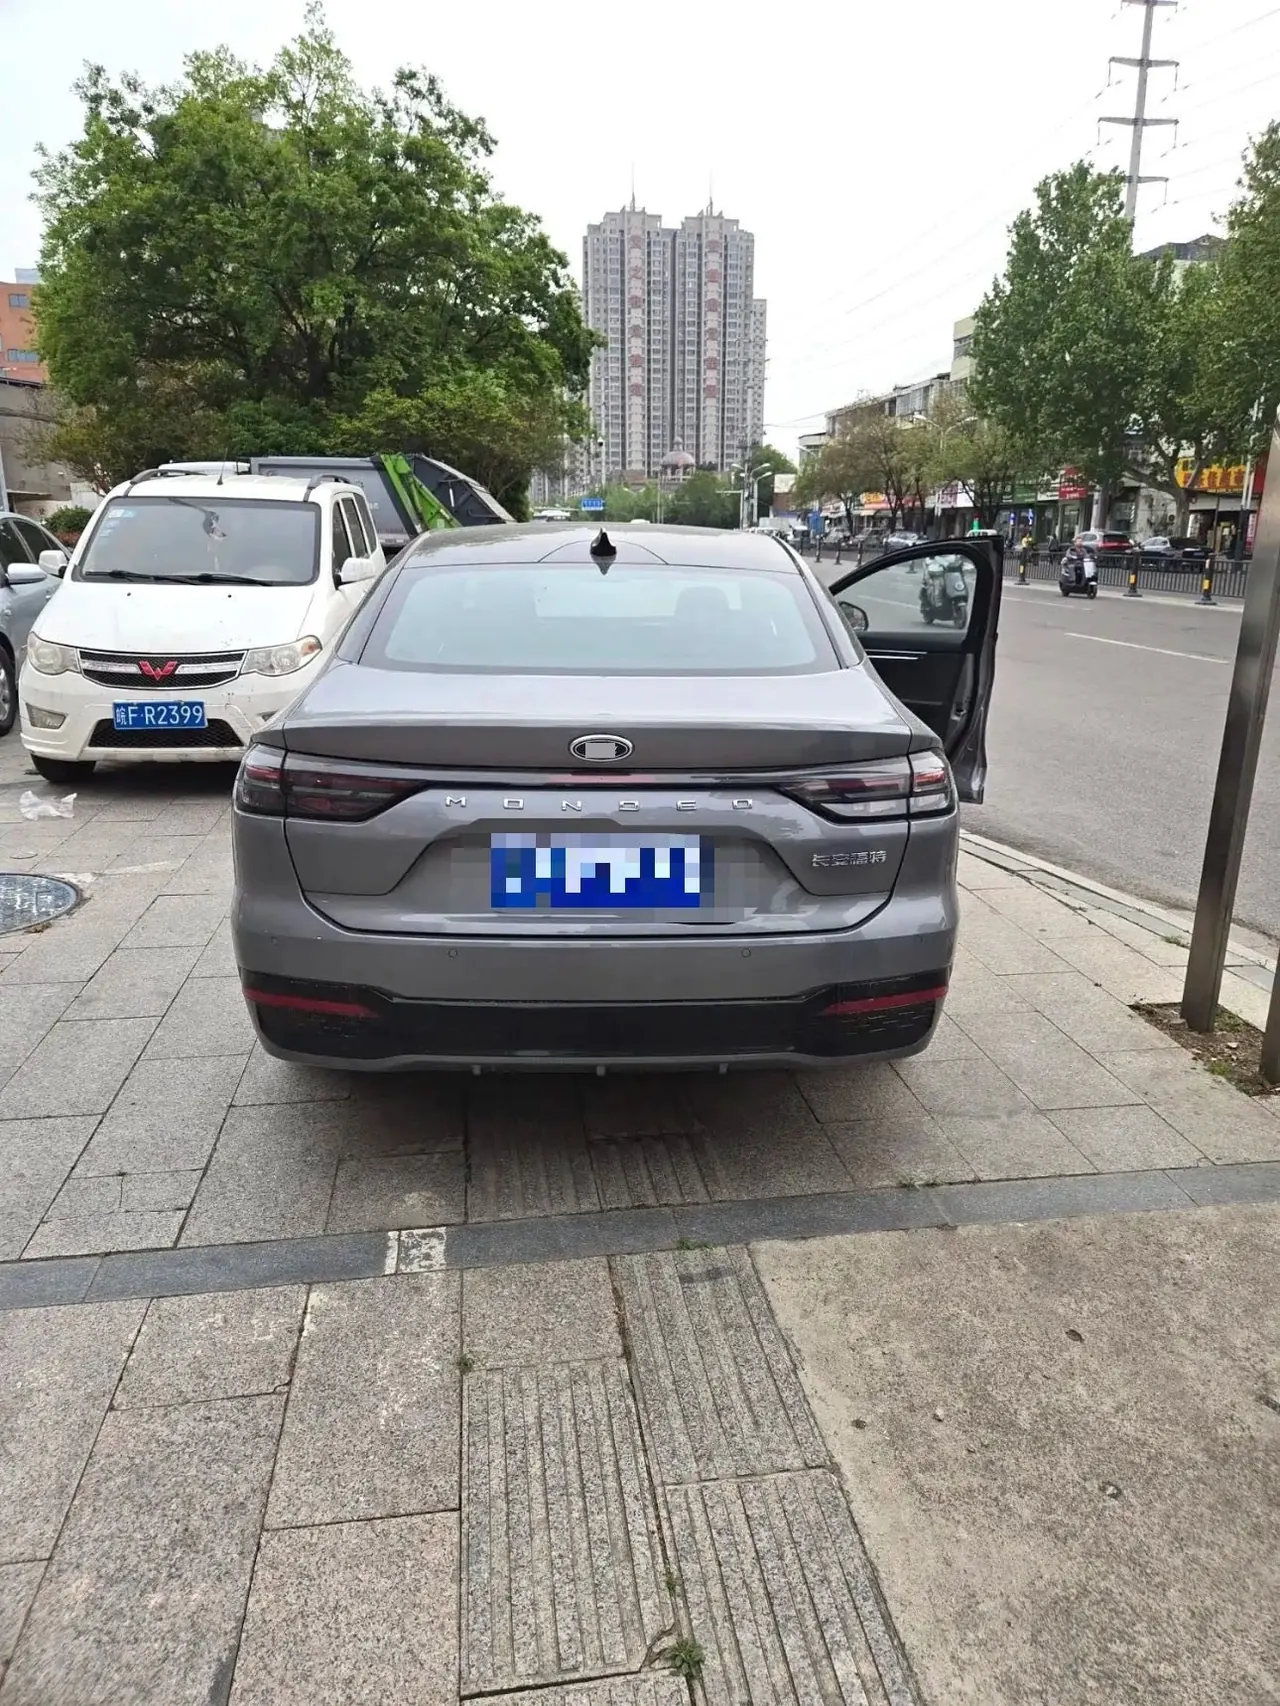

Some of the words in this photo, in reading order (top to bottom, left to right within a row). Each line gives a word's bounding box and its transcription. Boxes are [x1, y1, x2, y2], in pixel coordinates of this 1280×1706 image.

[445, 796, 753, 812] MONDEO
[812, 850, 887, 867] 长安福特
